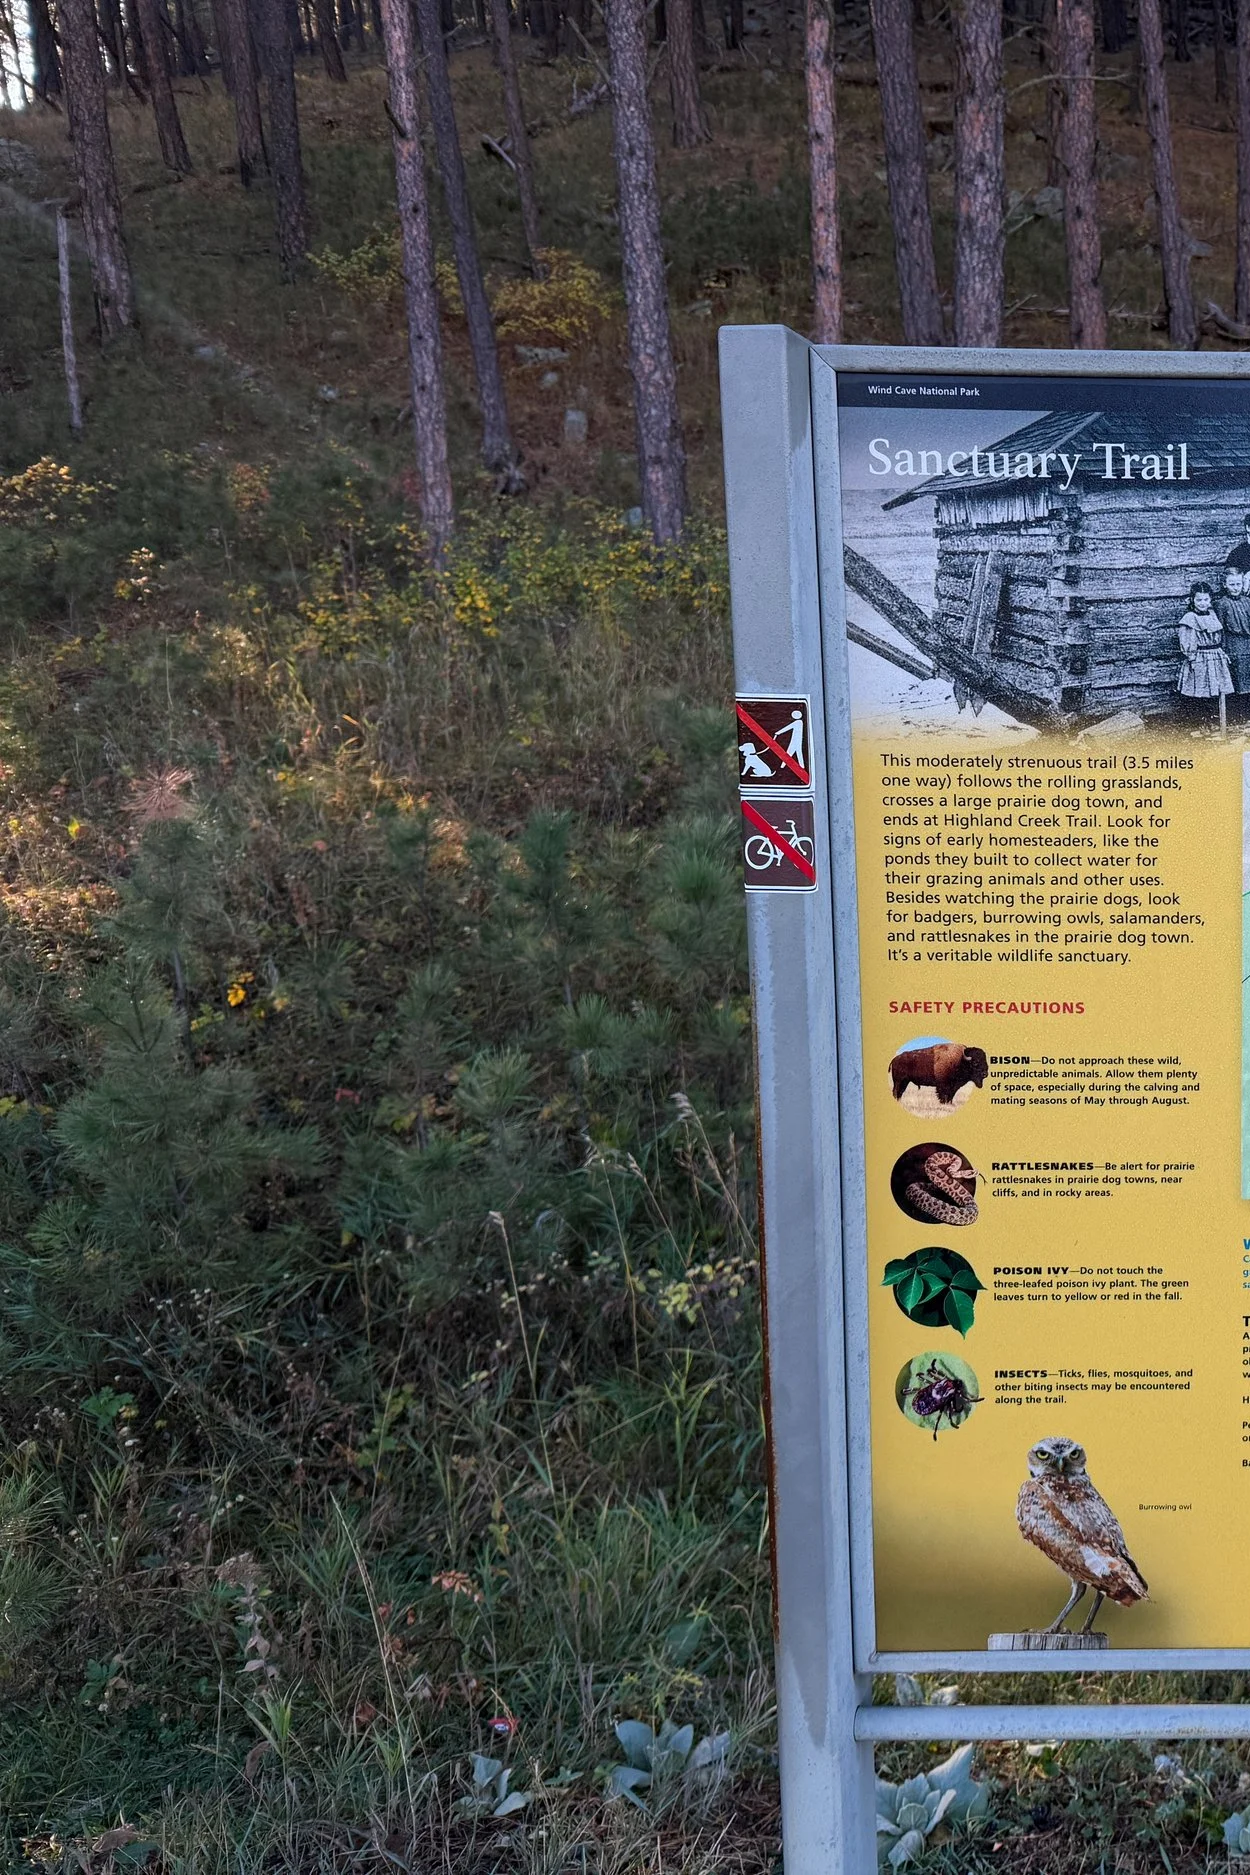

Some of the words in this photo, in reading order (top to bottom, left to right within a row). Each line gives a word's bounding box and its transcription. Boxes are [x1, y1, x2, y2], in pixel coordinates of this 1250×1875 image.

[867, 385, 892, 394] Wind
[894, 385, 916, 394] Cave
[919, 386, 957, 395] National
[960, 387, 979, 396] Park
[868, 438, 1082, 489] Sanctuary
[1092, 443, 1192, 481] Trail
[879, 752, 911, 767] This
[916, 753, 1003, 771] moderately
[1007, 756, 1082, 768] strenuous
[1086, 755, 1116, 769] trail
[1122, 755, 1149, 771] (3.5
[1155, 755, 1193, 769] miles
[881, 776, 910, 786] one
[915, 773, 951, 790] way)
[956, 773, 1012, 788] follows
[1016, 774, 1042, 788] the
[1047, 774, 1095, 791] rolling
[1101, 775, 1181, 792] grasslands,
[882, 796, 933, 806] crosses
[939, 796, 947, 806] a
[953, 793, 991, 810] large
[997, 794, 1046, 810] prairie
[1051, 794, 1080, 811] dog
[1085, 796, 1128, 809] town,
[1134, 795, 1162, 808] and
[883, 812, 918, 825] ends
[923, 814, 938, 826] at
[944, 813, 1012, 830] Highland
[1018, 813, 1060, 827] Creek
[1065, 814, 1101, 827] Trail.
[1107, 814, 1143, 827] Look
[1148, 814, 1171, 828] for
[889, 1001, 955, 1013] SAFETY
[962, 1001, 1084, 1014] PRECAUTIONS
[1078, 1055, 1124, 1067] approach
[1127, 1055, 1154, 1064] these
[1157, 1055, 1181, 1065] wild,
[990, 1068, 1058, 1080] unpredictable
[1061, 1069, 1102, 1078] animals.
[1105, 1069, 1134, 1078] Allow
[1137, 1069, 1163, 1078] them
[1166, 1069, 1197, 1080] plenty
[1119, 1161, 1143, 1170] alert
[1145, 1161, 1160, 1170] for
[1163, 1161, 1194, 1172] prairie
[993, 1266, 1042, 1275] POISON
[1116, 1266, 1143, 1274] touch
[1147, 1265, 1163, 1274] the
[1087, 1368, 1110, 1378] flies,
[1113, 1368, 1171, 1379] mosquitoes,
[1174, 1368, 1192, 1377] and
[1138, 1503, 1176, 1511] Burrowing
